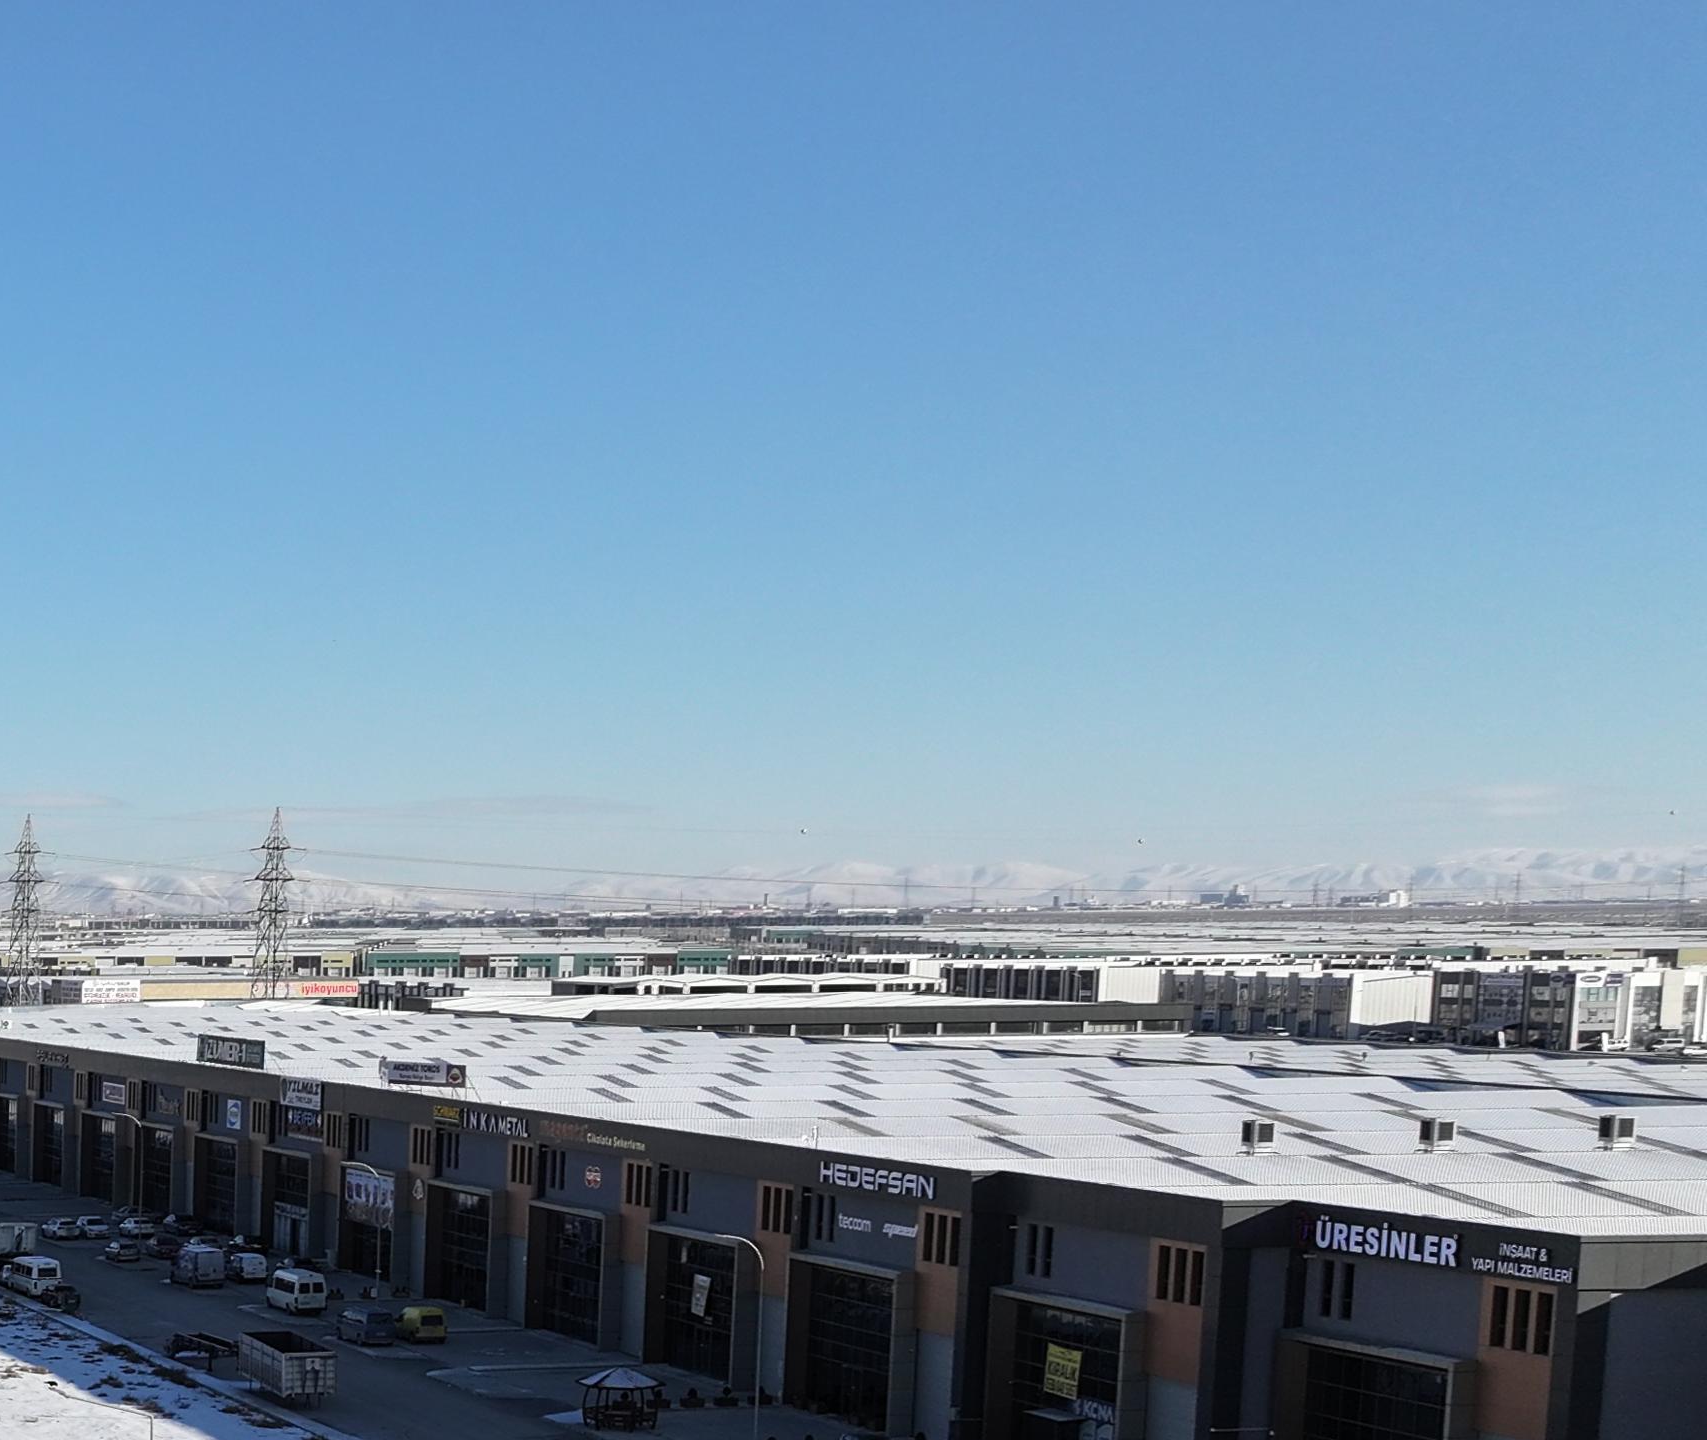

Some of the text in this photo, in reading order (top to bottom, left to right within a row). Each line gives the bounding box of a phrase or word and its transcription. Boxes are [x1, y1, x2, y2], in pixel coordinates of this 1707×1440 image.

[819, 1161, 934, 1200] HEDEFSAN
[1315, 1215, 1457, 1268] ÜRESİNLER
[1472, 1257, 1573, 1284] YAPI MALZEMELERİ
